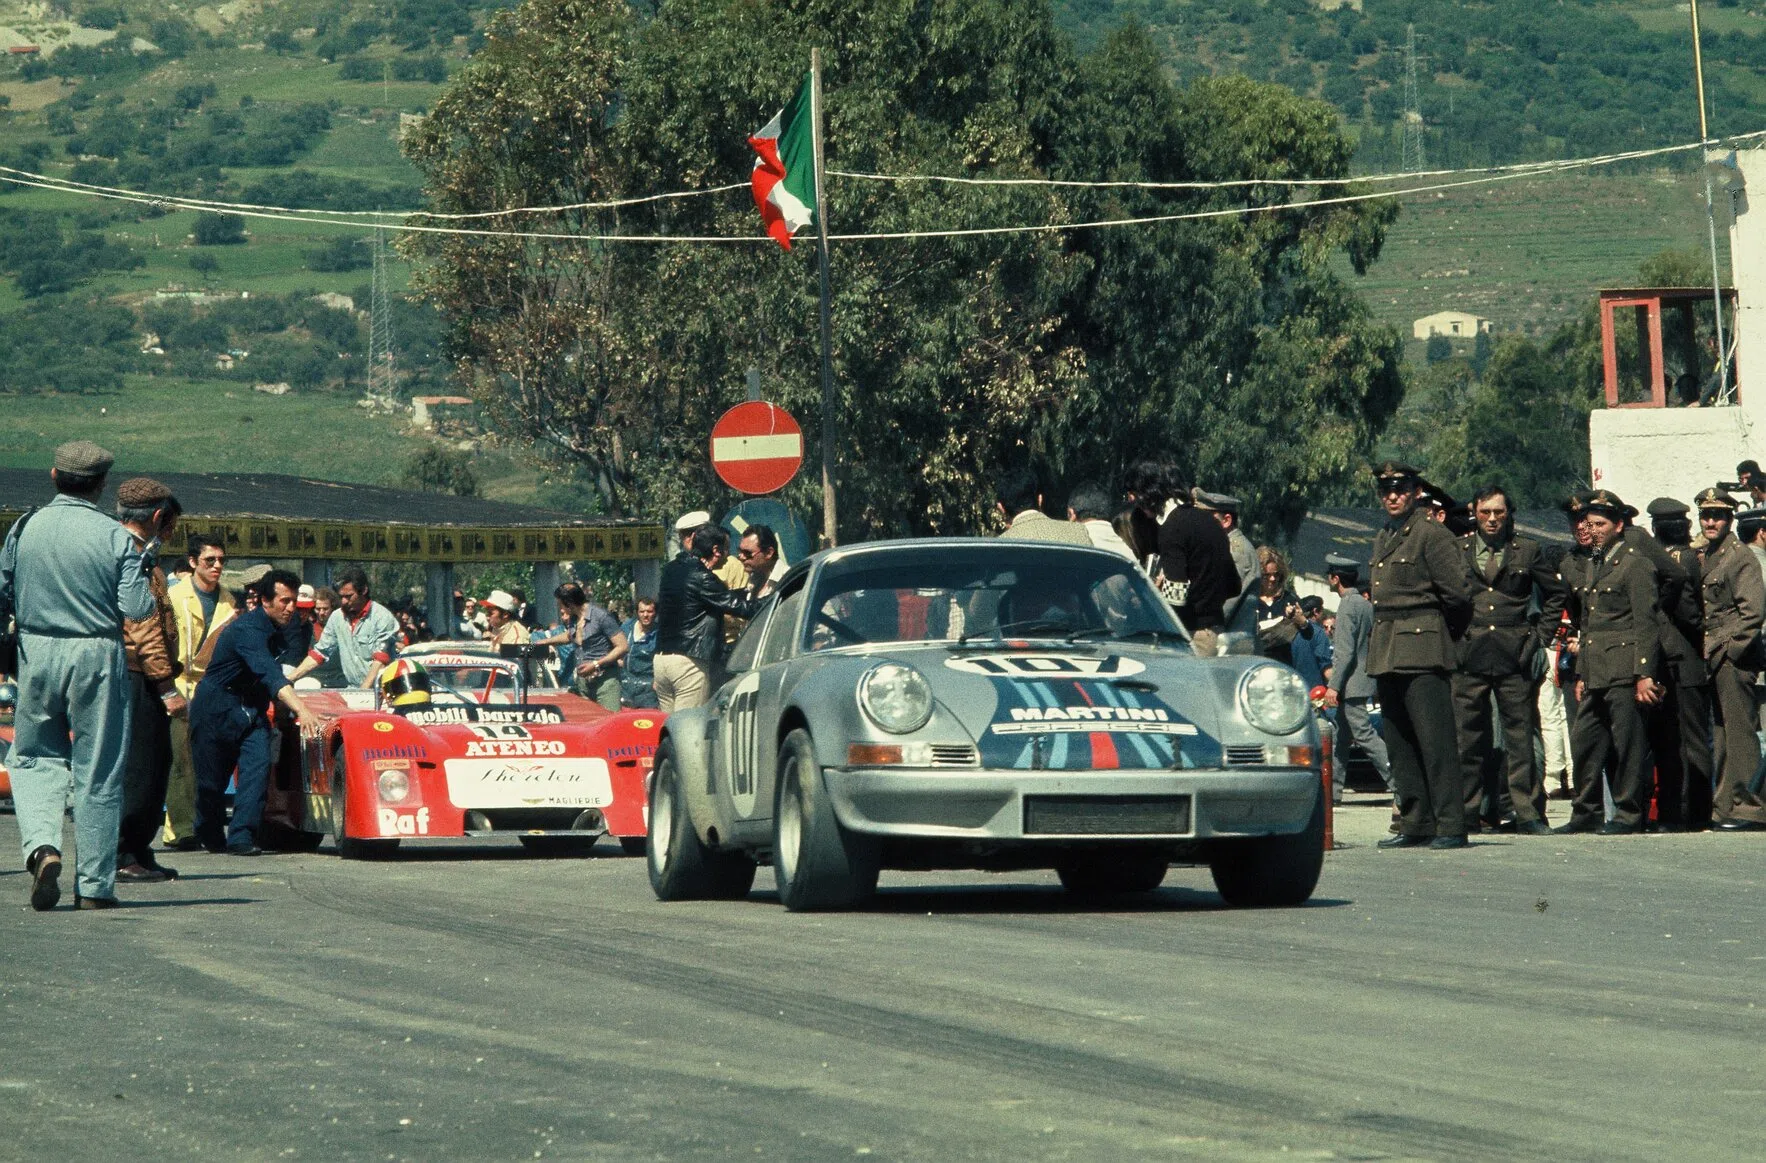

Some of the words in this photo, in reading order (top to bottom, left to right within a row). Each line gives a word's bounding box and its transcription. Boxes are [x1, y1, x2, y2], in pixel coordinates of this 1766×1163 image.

[967, 655, 1120, 673] 107
[405, 707, 469, 725] mobili
[1010, 706, 1169, 721] MARTINI
[363, 744, 427, 760] mobili
[465, 740, 566, 756] ATENEO
[608, 744, 659, 760] barr
[729, 691, 758, 796] 107
[378, 807, 430, 836] Raf
